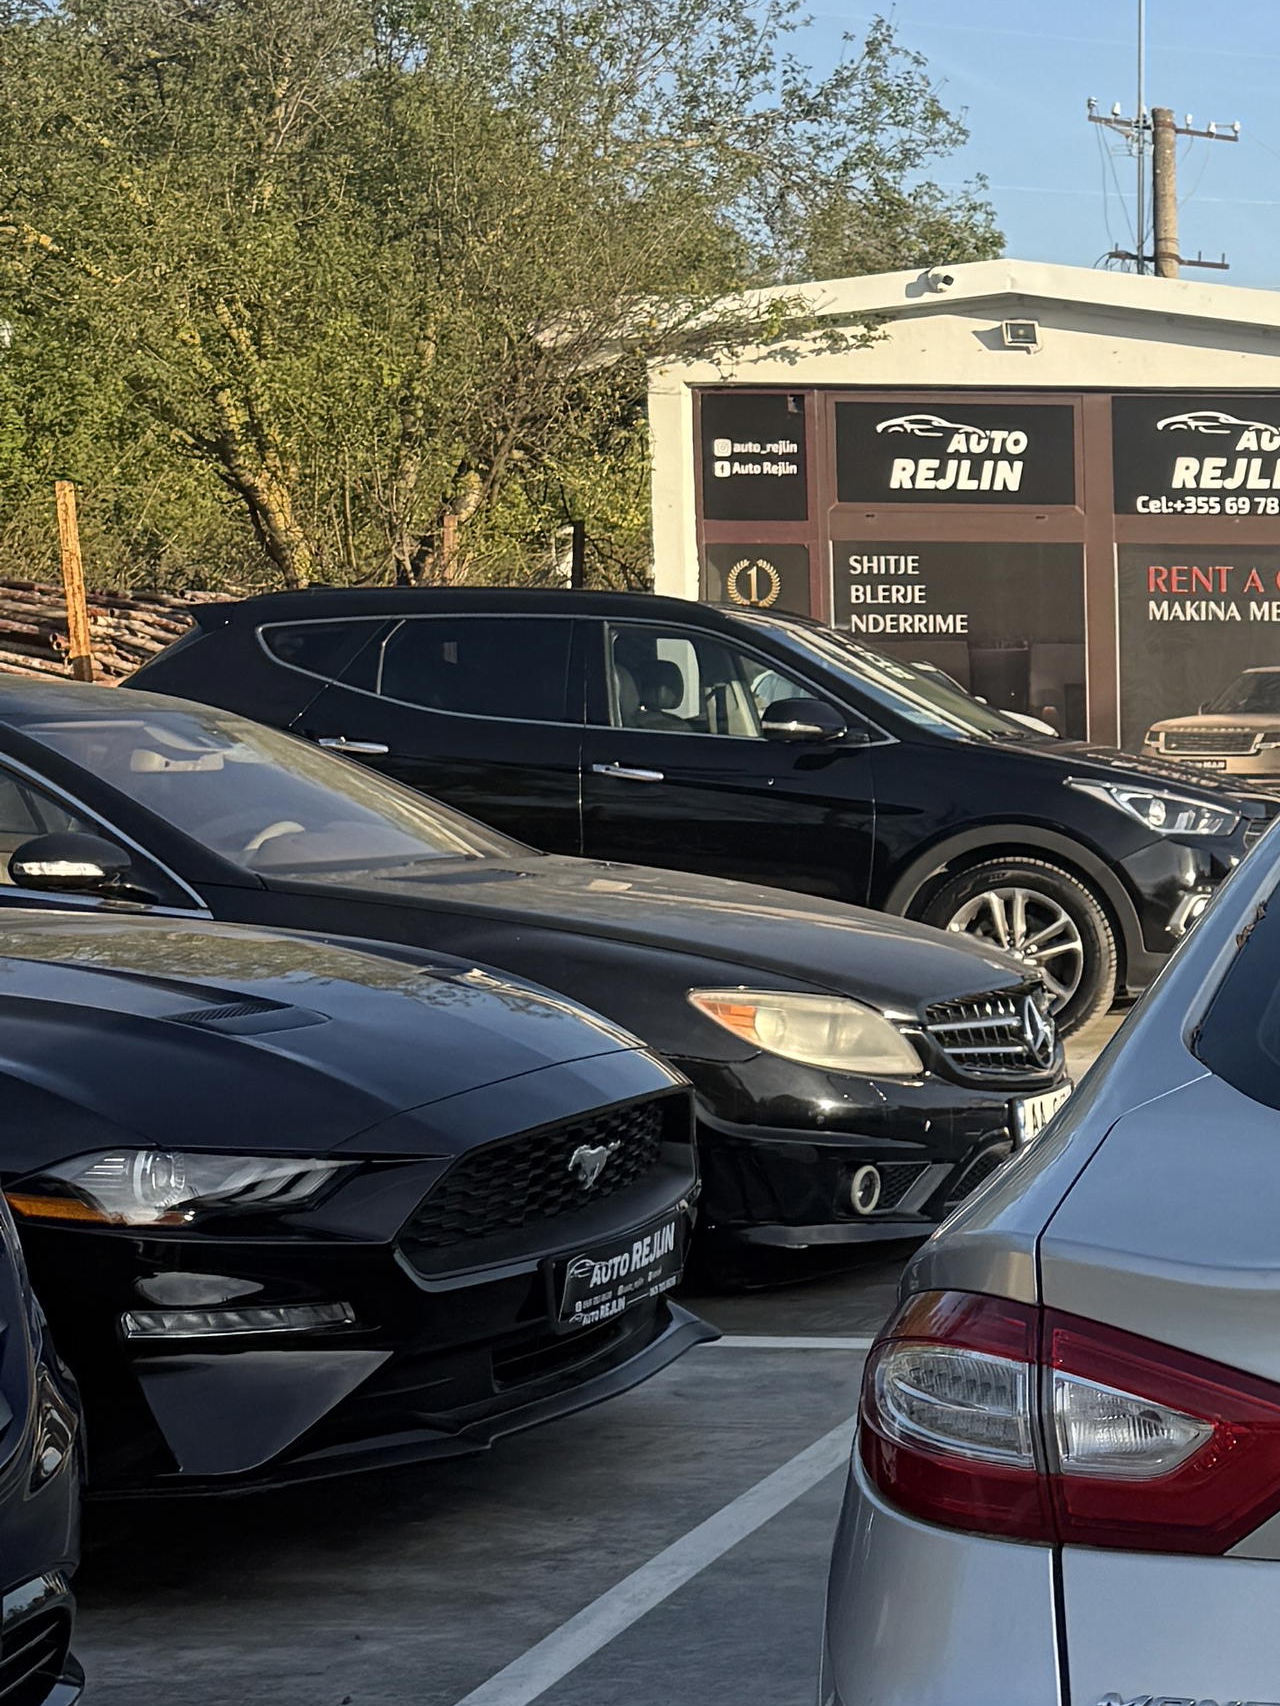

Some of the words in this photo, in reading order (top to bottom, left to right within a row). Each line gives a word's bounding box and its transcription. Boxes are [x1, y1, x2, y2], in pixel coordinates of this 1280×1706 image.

[733, 440, 798, 456] auto_rejlin
[946, 430, 1028, 455] AUTO
[732, 461, 761, 475] Auto
[762, 461, 798, 477] Rejlin
[889, 458, 1024, 491] REJLIN
[1136, 495, 1221, 514] Cel:+355
[1224, 496, 1251, 515] 69
[1254, 496, 1279, 515] 78
[849, 555, 919, 575] SHITJE
[1147, 566, 1234, 593] RENT
[1243, 567, 1265, 593] A
[850, 584, 927, 604] BLERJE
[1149, 600, 1242, 621] MAKINA
[850, 613, 968, 634] NDERRIME
[589, 1252, 630, 1288] AUTO
[630, 1221, 676, 1273] REJLIN
